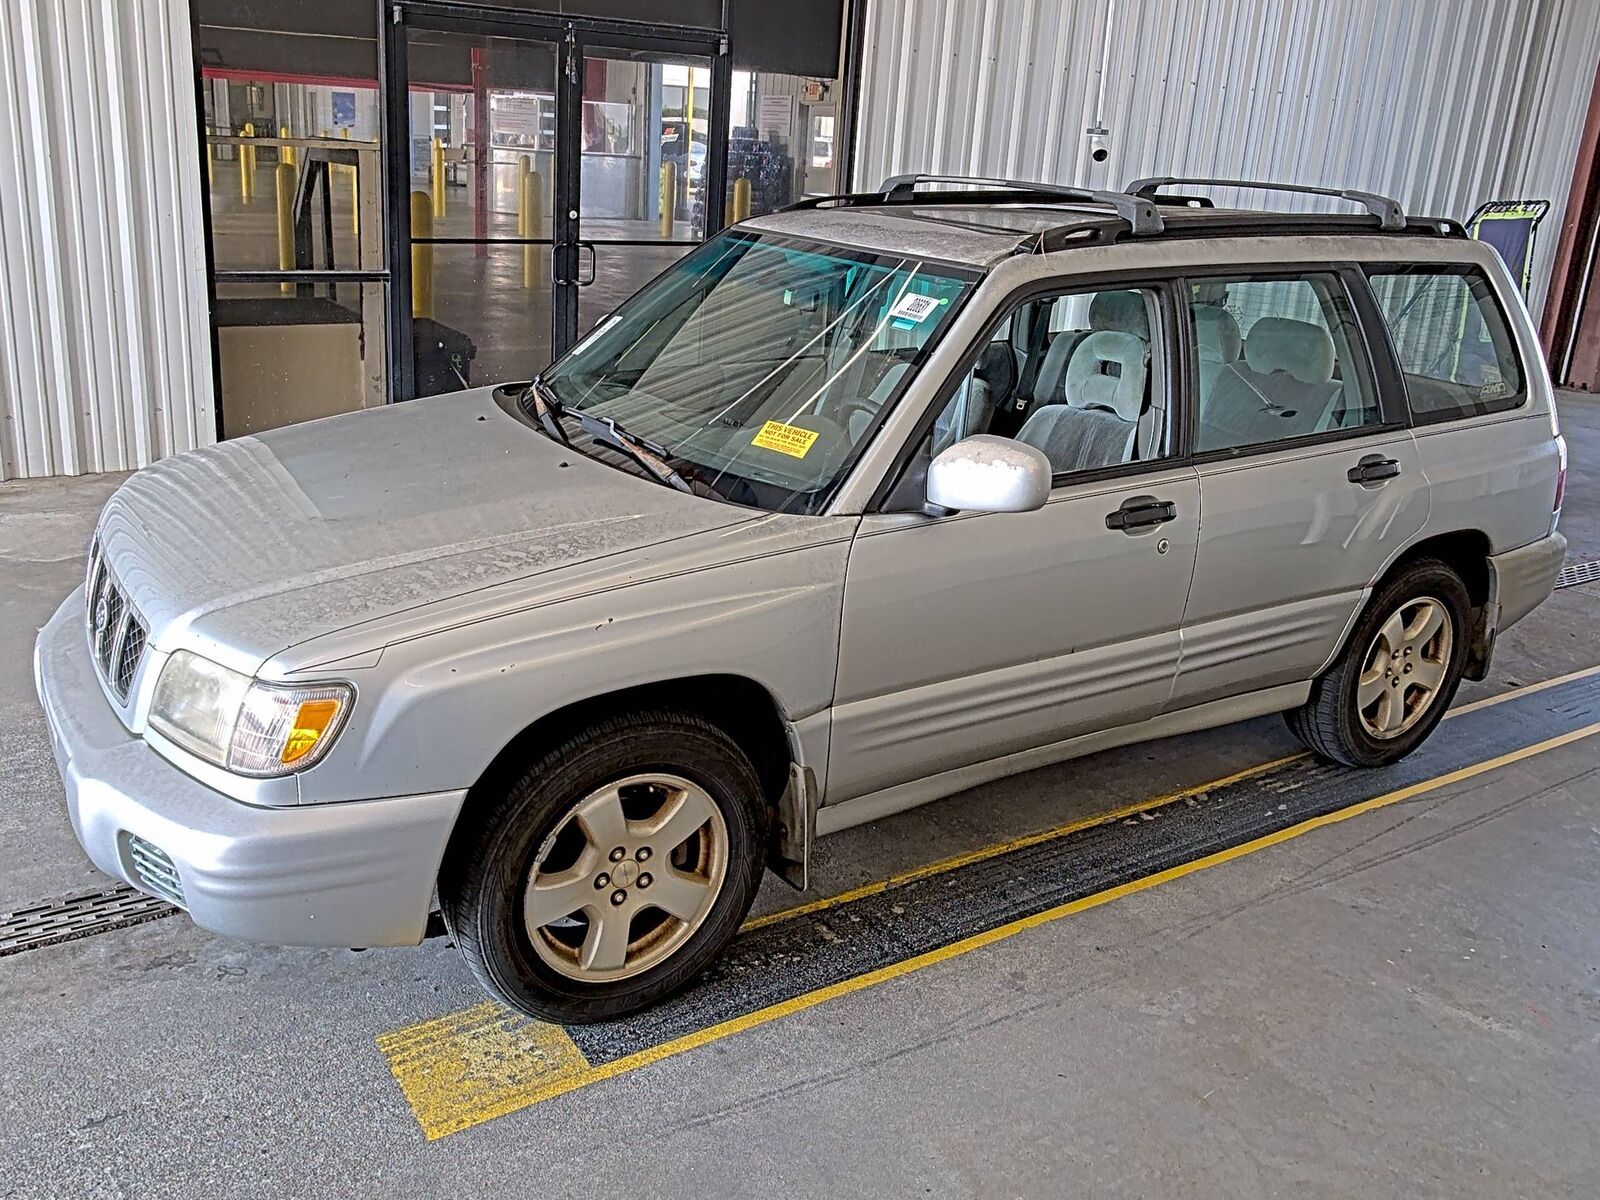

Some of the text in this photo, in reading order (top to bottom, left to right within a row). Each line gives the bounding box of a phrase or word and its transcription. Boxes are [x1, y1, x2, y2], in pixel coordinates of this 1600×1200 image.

[763, 429, 777, 437] NOT
[777, 432, 791, 440] FOR
[791, 436, 808, 446] SALE
[766, 422, 814, 440] THIS VEHICLE
